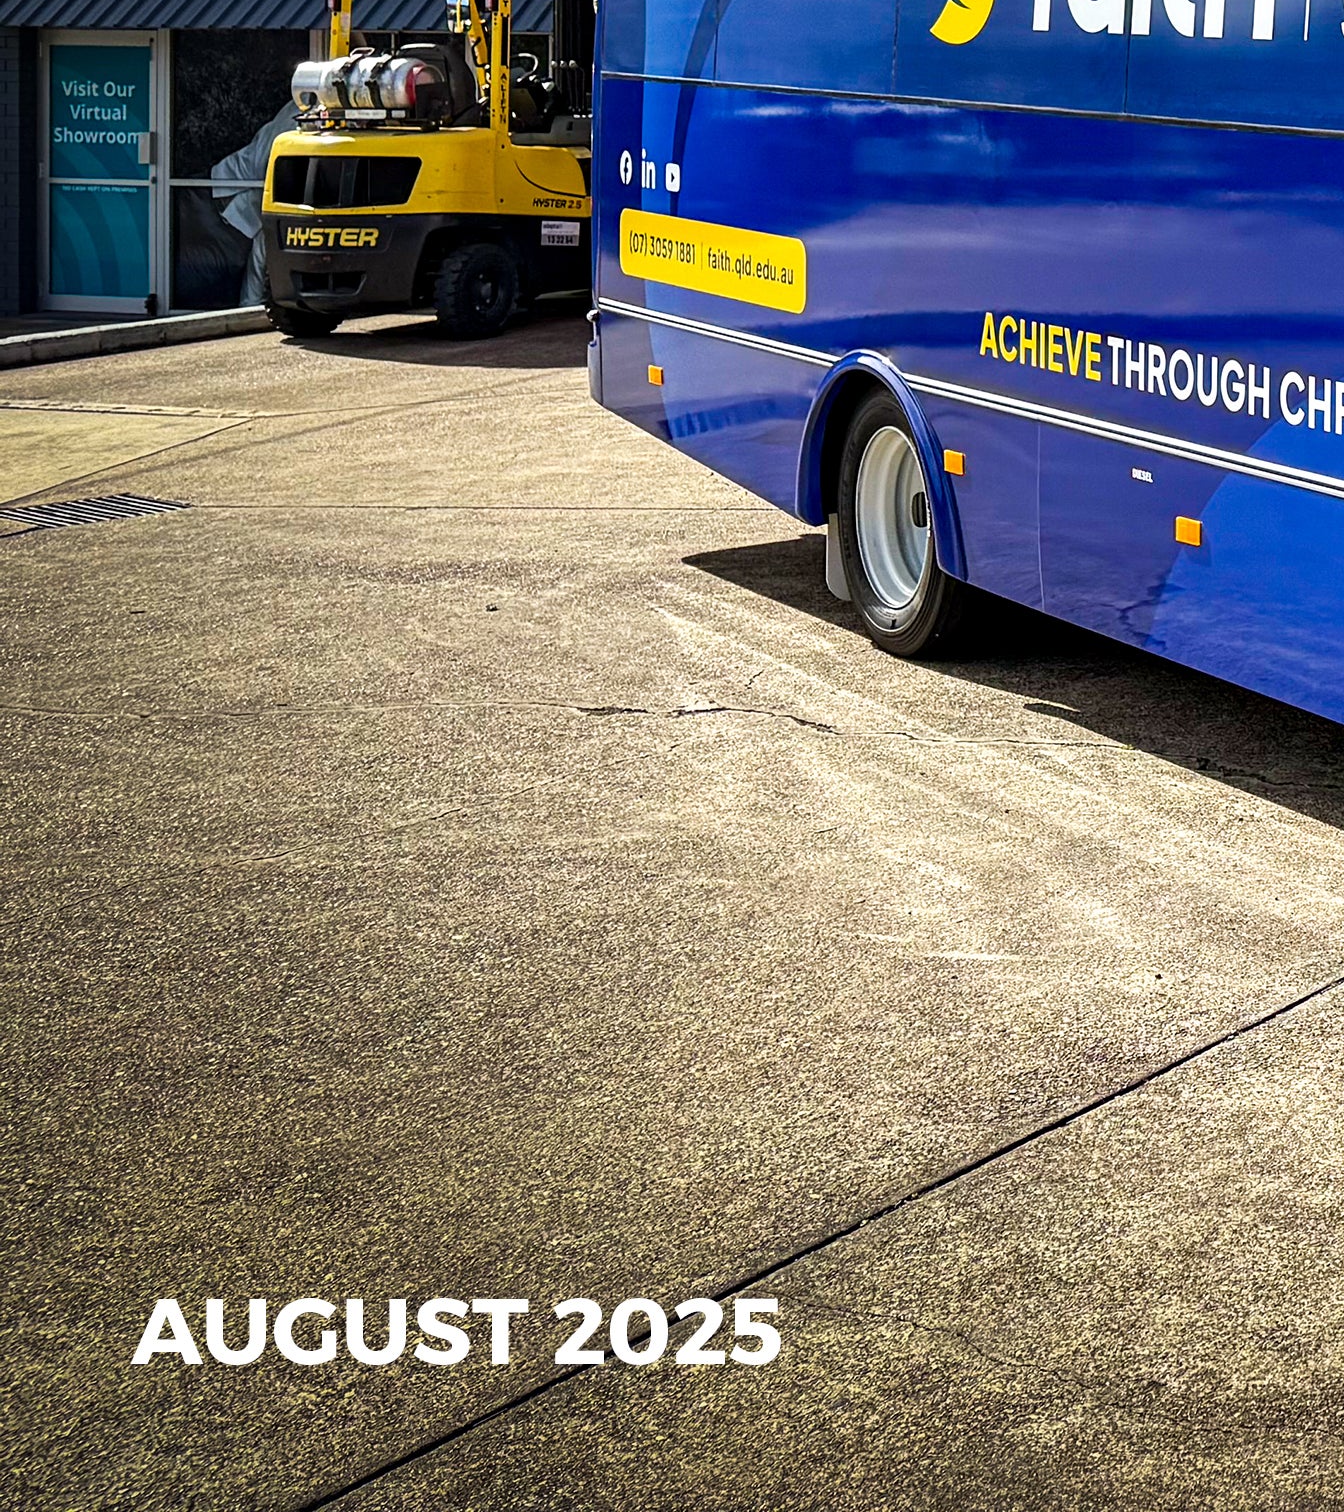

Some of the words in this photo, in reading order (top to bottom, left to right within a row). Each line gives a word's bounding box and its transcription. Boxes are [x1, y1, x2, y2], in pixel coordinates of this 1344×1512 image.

[62, 80, 99, 97] Visit
[103, 81, 136, 98] Our
[69, 103, 127, 121] Virtual
[533, 197, 567, 208] HYSTER
[286, 227, 379, 247] HYSTER
[629, 230, 648, 257] (07)
[649, 235, 673, 260] 3059
[675, 241, 696, 265] 1881
[708, 248, 794, 285] faith.qld.edu.au
[980, 312, 1102, 382] ACHIEVE
[1106, 336, 1270, 419] THROUGH
